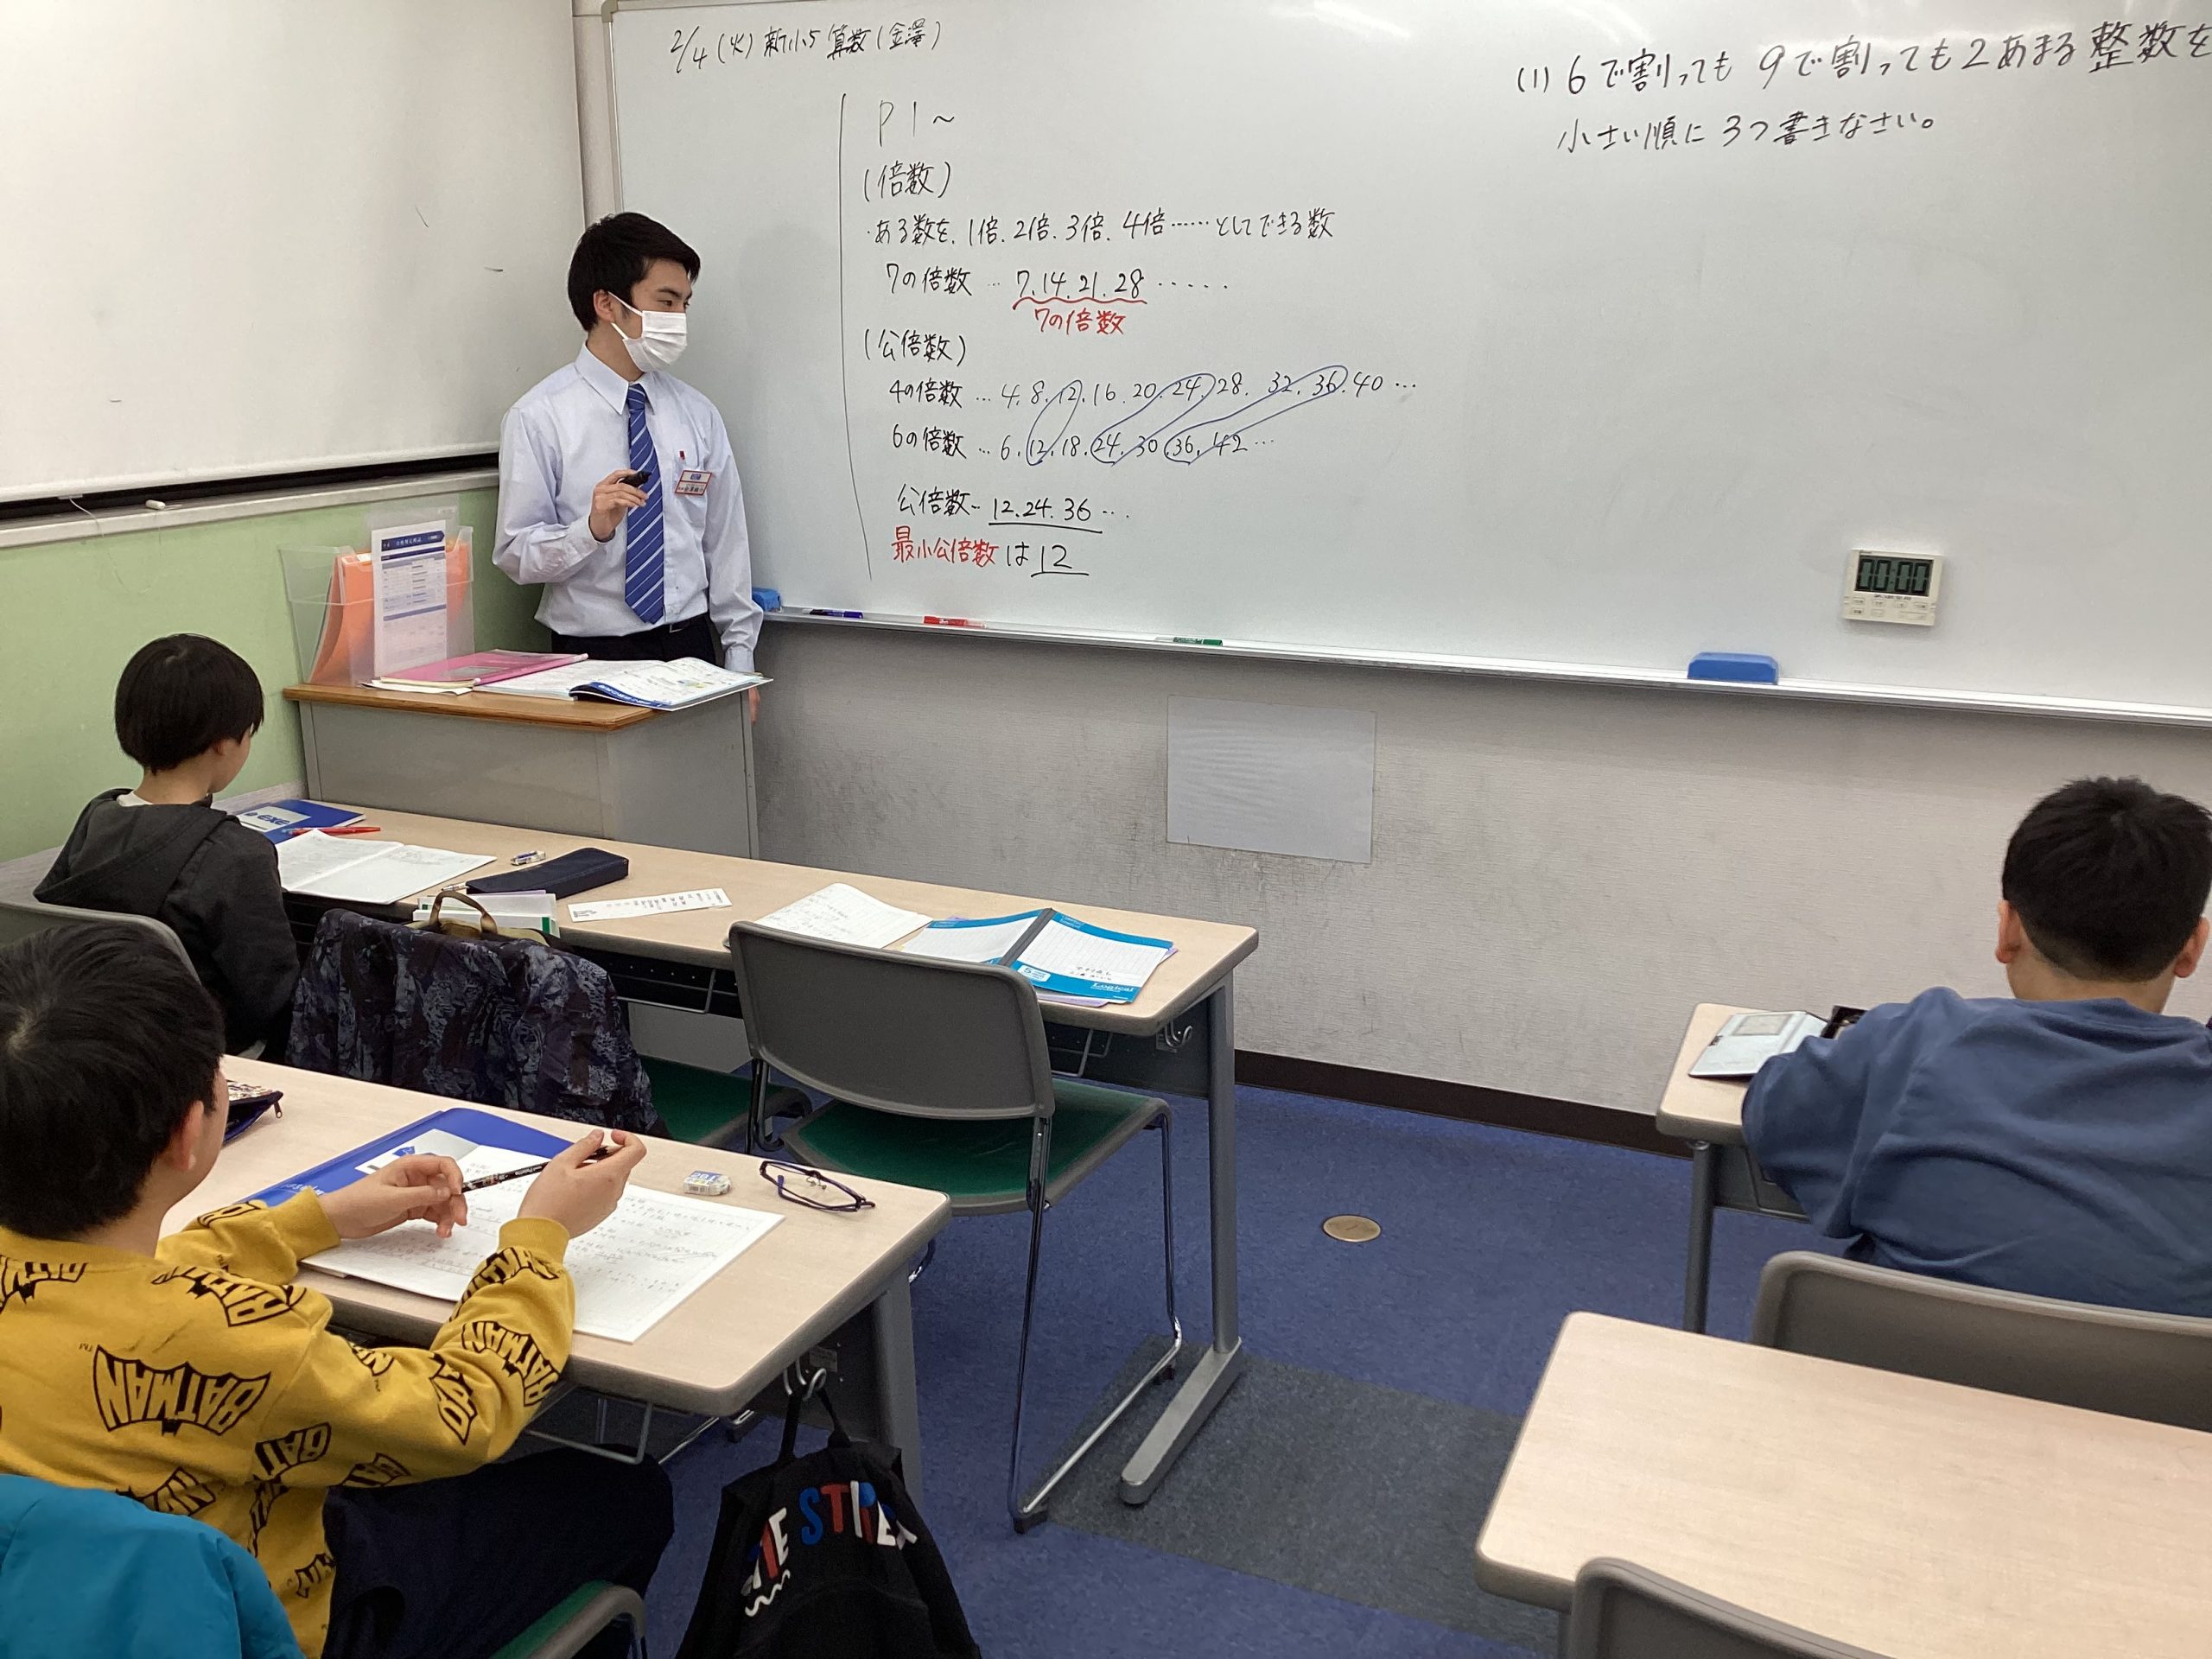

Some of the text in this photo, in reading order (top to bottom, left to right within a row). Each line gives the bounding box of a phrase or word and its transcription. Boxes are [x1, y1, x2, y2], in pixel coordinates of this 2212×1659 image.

[1034, 308, 1126, 335] 7の倍数
[1091, 982, 1135, 993] Logical
[93, 1344, 271, 1436] BATMAN
[461, 1321, 560, 1407] BATMAN
